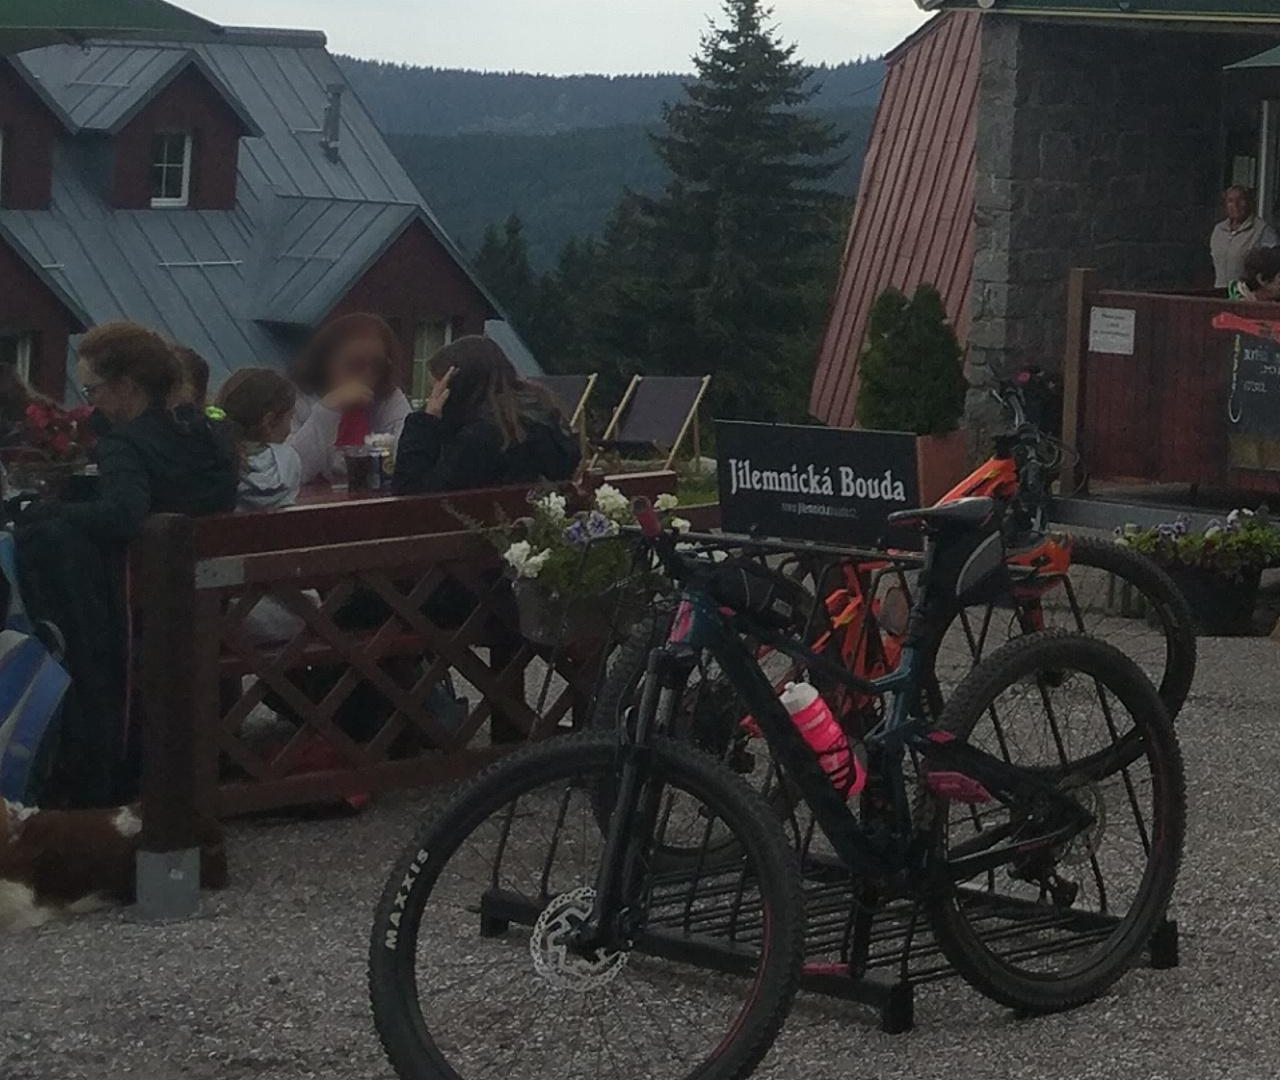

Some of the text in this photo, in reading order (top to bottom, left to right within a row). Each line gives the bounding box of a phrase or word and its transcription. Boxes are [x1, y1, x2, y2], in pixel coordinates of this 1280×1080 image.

[728, 457, 906, 501] Jilemnická Bouda
[384, 848, 429, 951] MAXXIS
